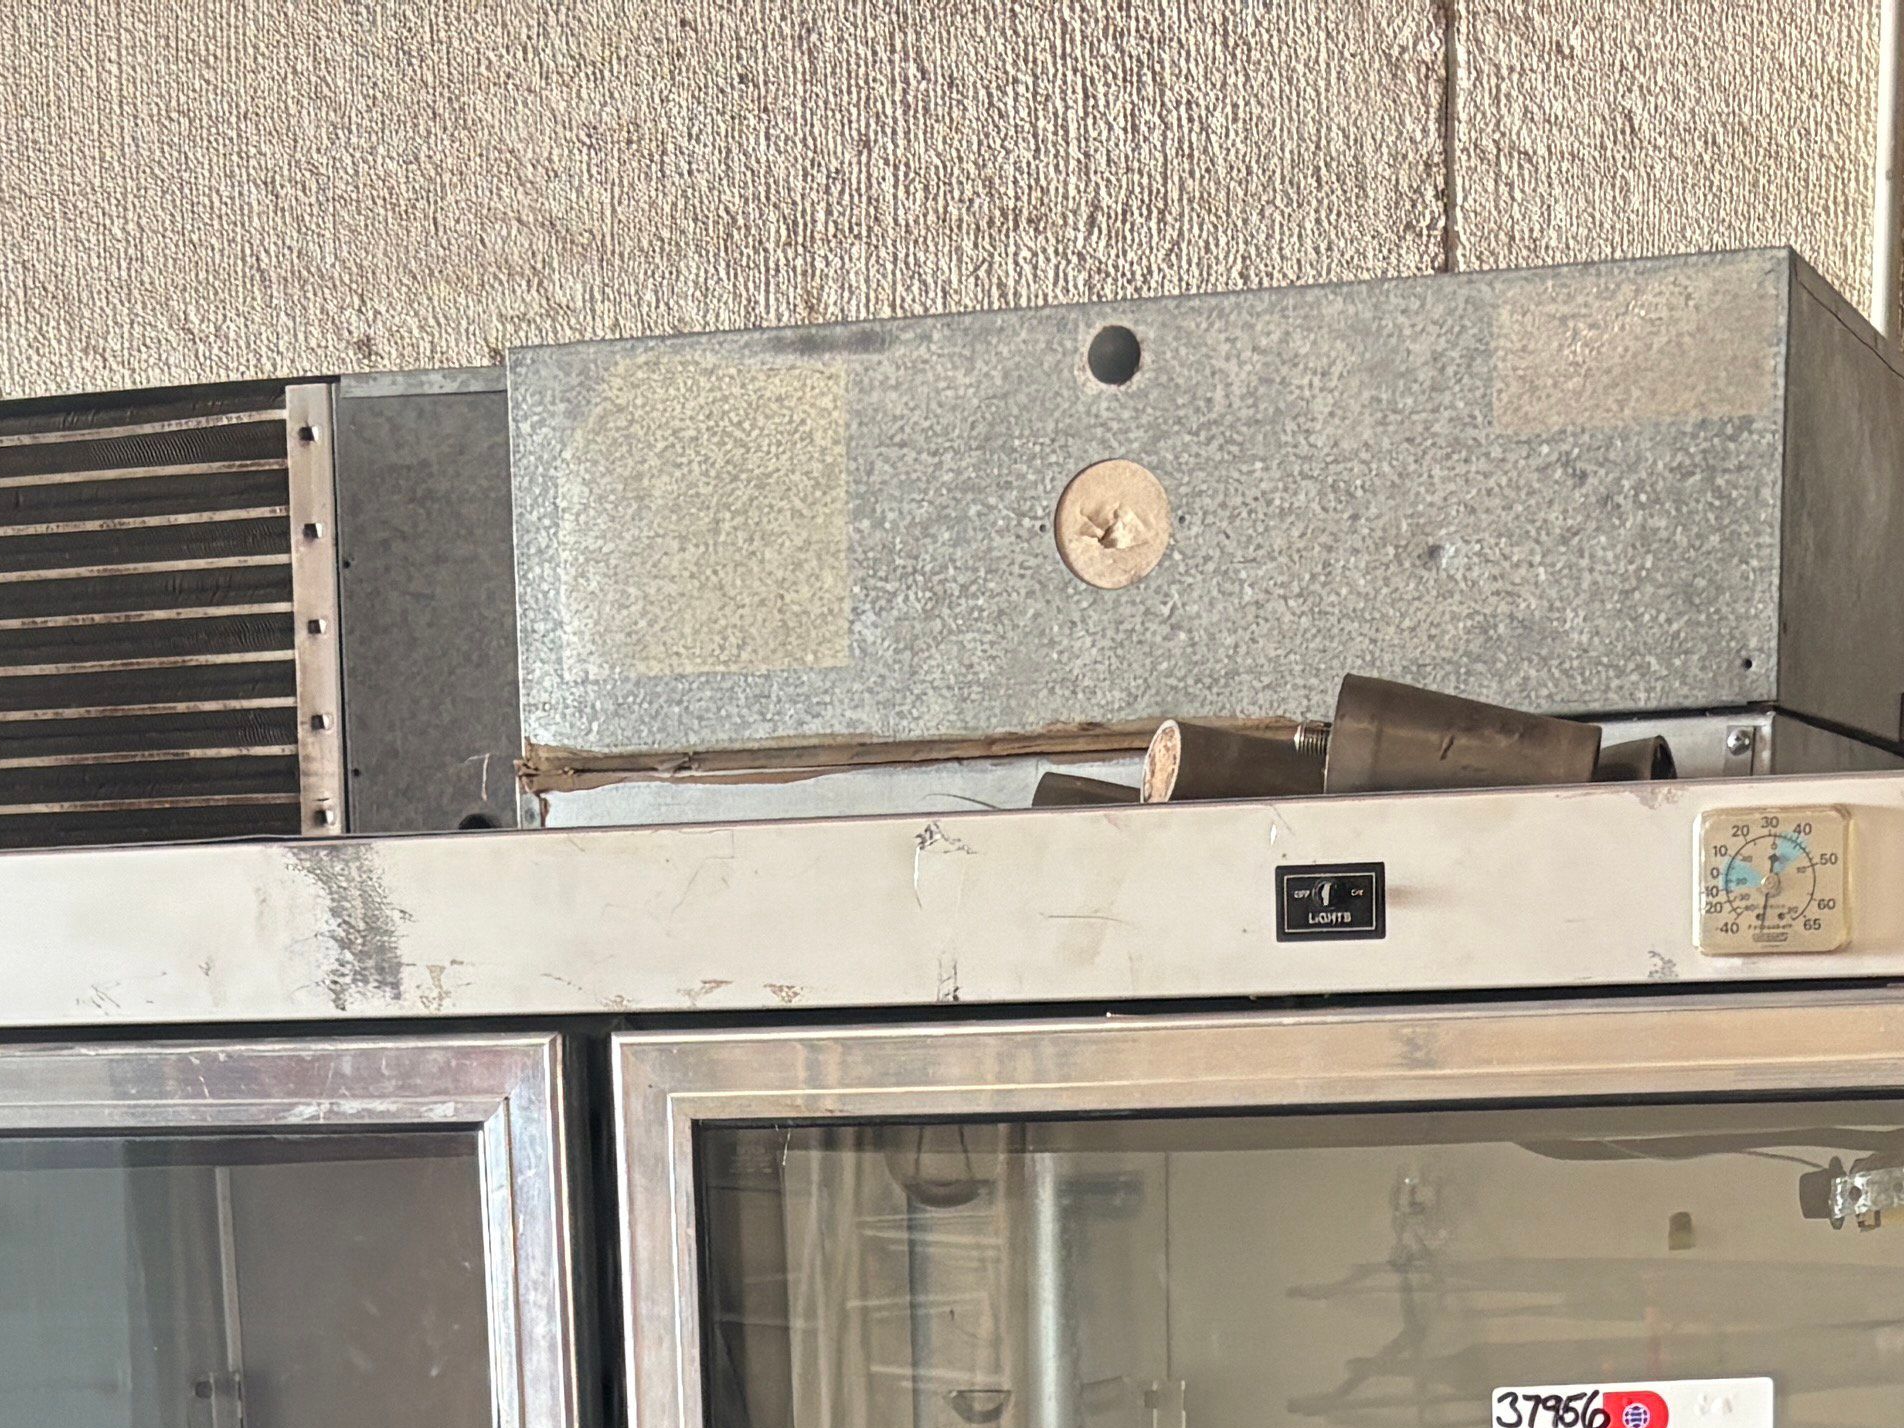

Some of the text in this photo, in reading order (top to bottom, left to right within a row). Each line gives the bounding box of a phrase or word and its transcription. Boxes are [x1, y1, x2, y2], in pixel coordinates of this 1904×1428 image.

[1760, 815, 1780, 829] 30
[1792, 821, 1813, 837] 40
[1731, 823, 1750, 838] 20
[1712, 844, 1729, 858] 10
[1819, 852, 1839, 866] 50
[1710, 867, 1720, 880] 0
[1817, 898, 1836, 910] 60
[1803, 918, 1822, 931] 65
